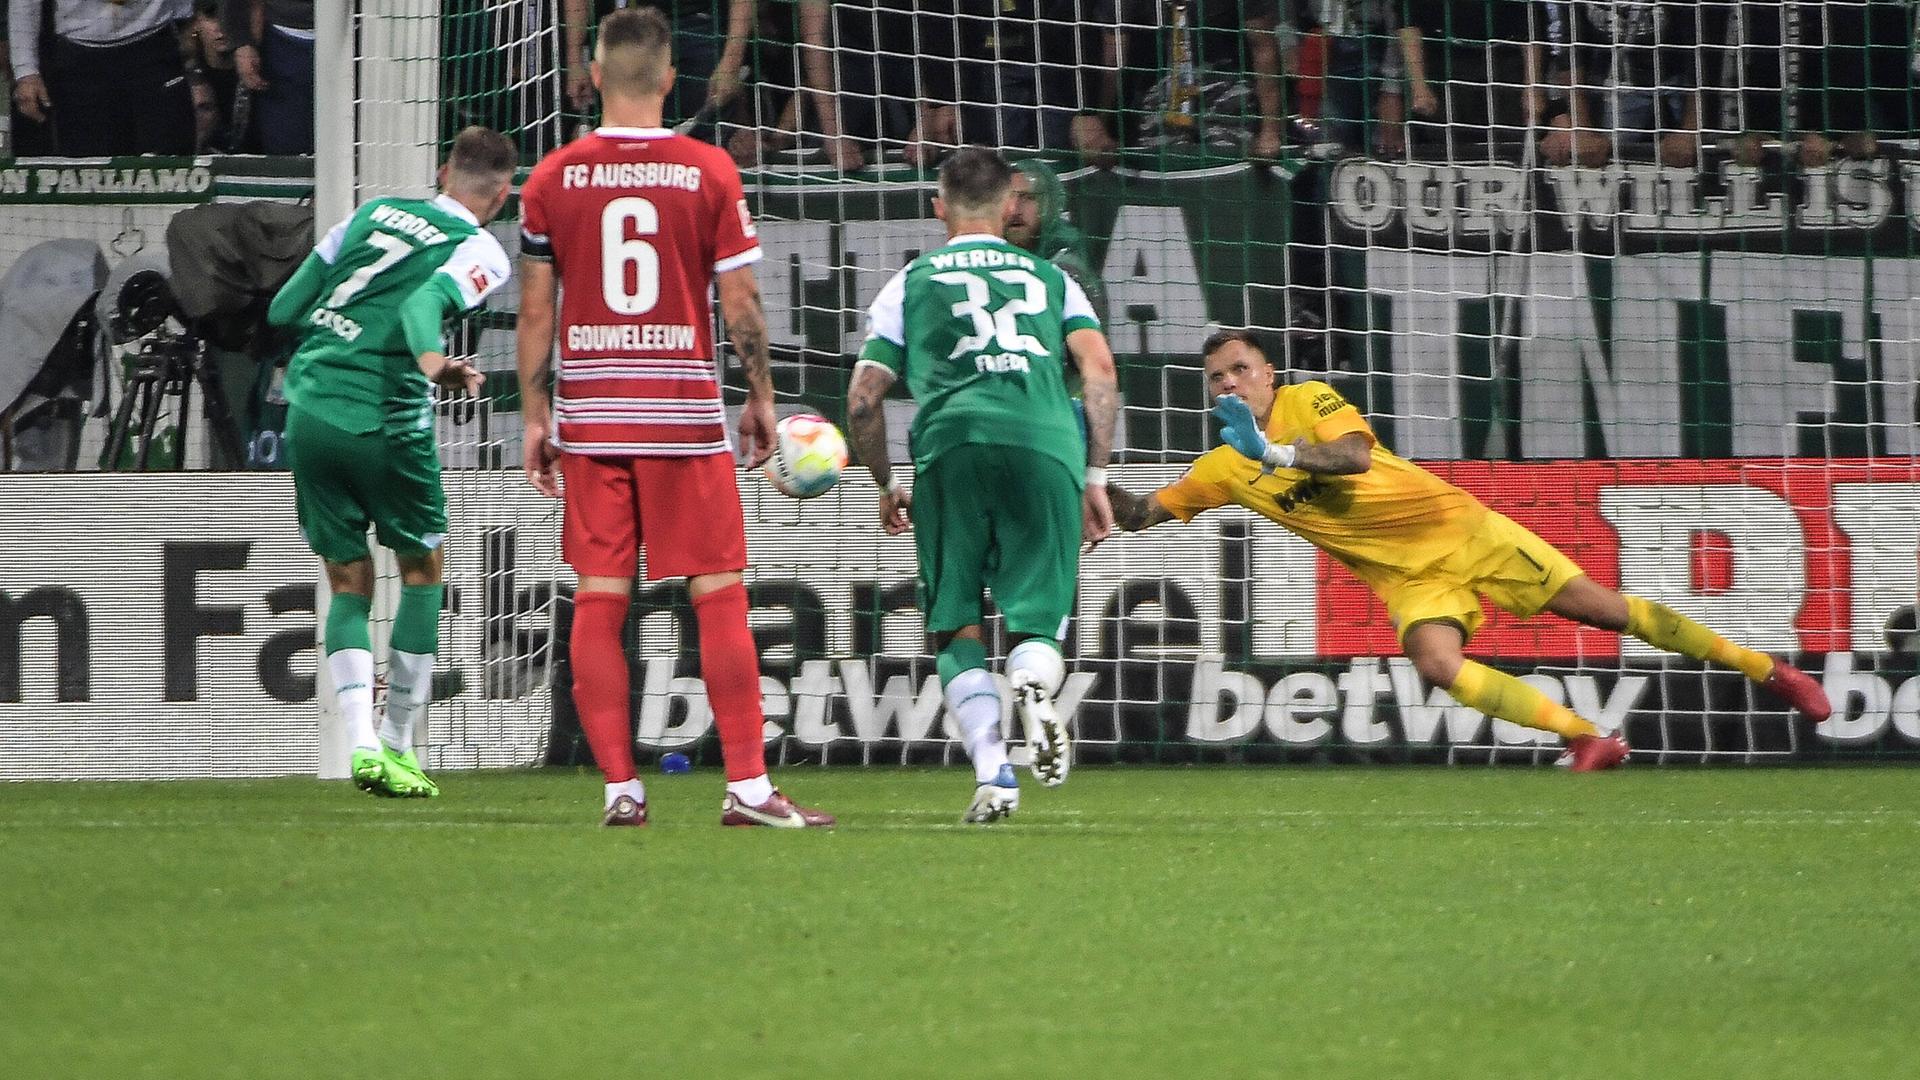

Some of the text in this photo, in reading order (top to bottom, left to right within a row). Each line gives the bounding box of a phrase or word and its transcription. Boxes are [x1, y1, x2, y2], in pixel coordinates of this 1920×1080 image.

[36, 168, 210, 194] PARLIAMO
[562, 162, 701, 191] FC AUGSBURG
[1332, 157, 1530, 235] OUR
[1543, 158, 1788, 233] WILL
[1796, 156, 1893, 230] IS
[327, 230, 414, 309] 7
[601, 196, 660, 316] 6
[567, 324, 695, 352] GOUWELEEUW
[929, 269, 1051, 360] 32
[1366, 250, 1920, 460] INF
